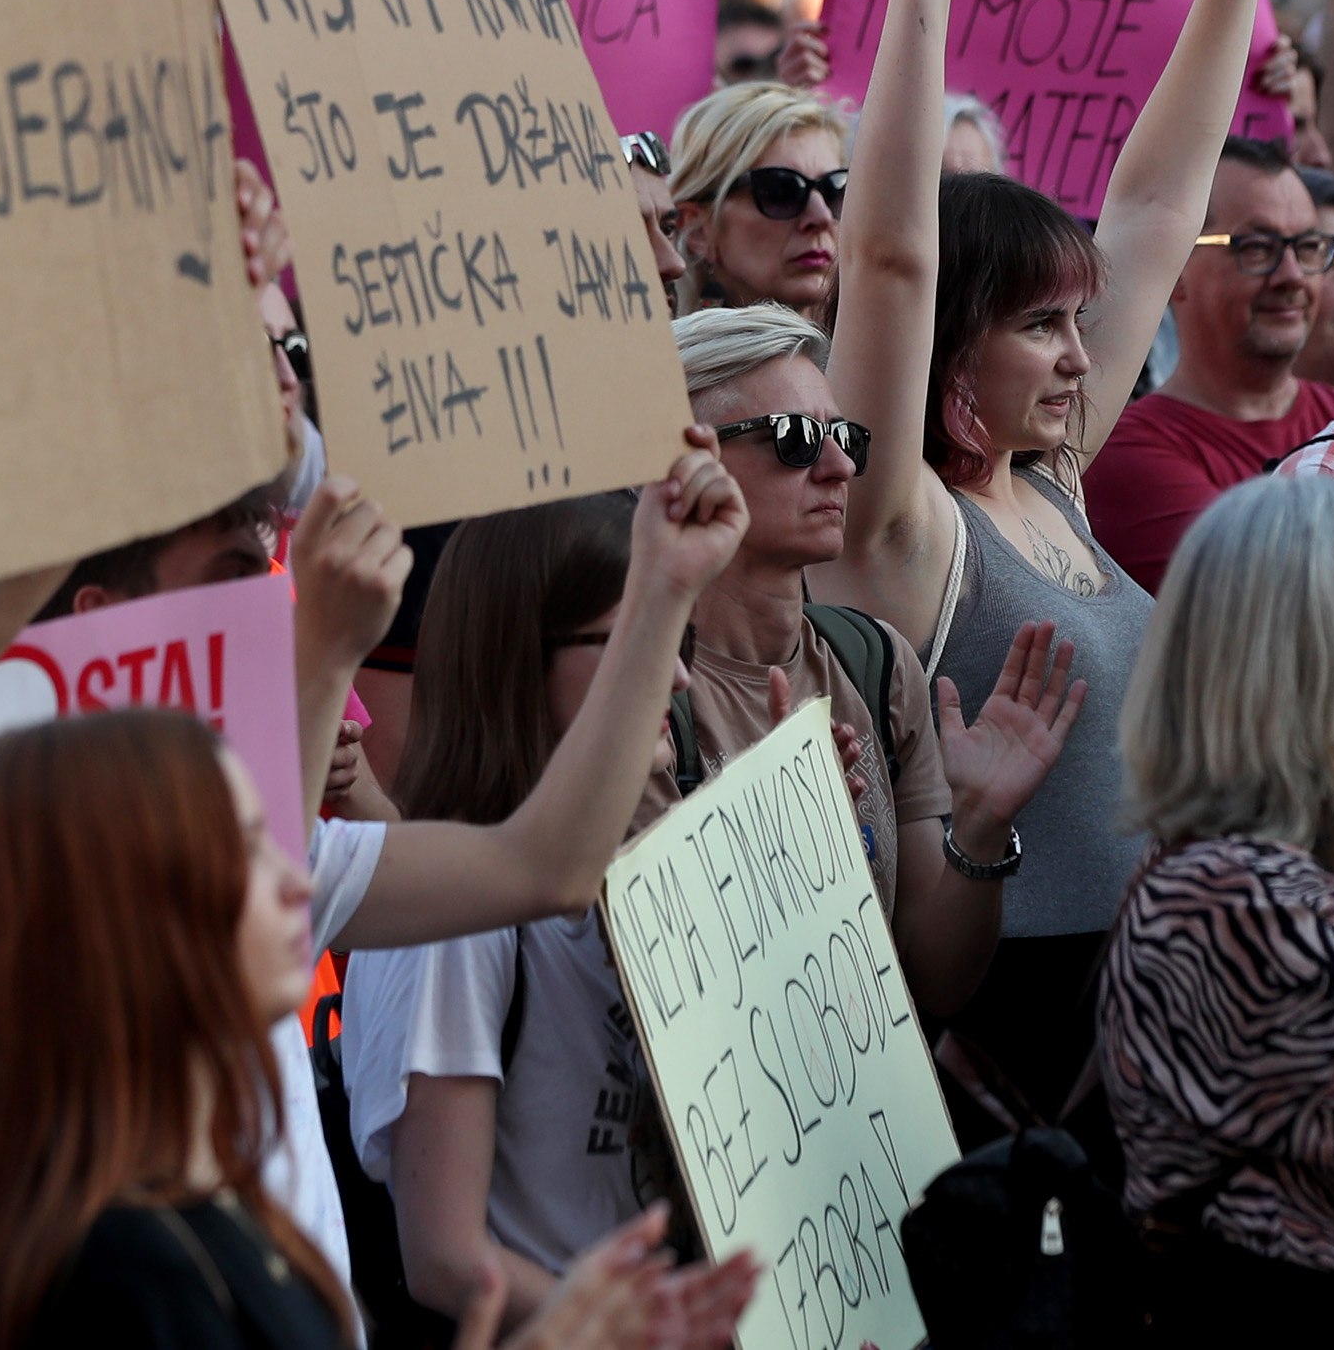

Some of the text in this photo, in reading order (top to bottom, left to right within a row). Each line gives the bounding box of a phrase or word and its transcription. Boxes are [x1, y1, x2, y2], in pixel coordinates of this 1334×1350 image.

[275, 72, 626, 194] ŠTO JE DRŽAVA
[332, 210, 653, 336] SEPTIČKA JAMA
[610, 860, 719, 1041] NEMA
[686, 1048, 769, 1237] BEZ
[749, 894, 911, 1165] SLOBODE
